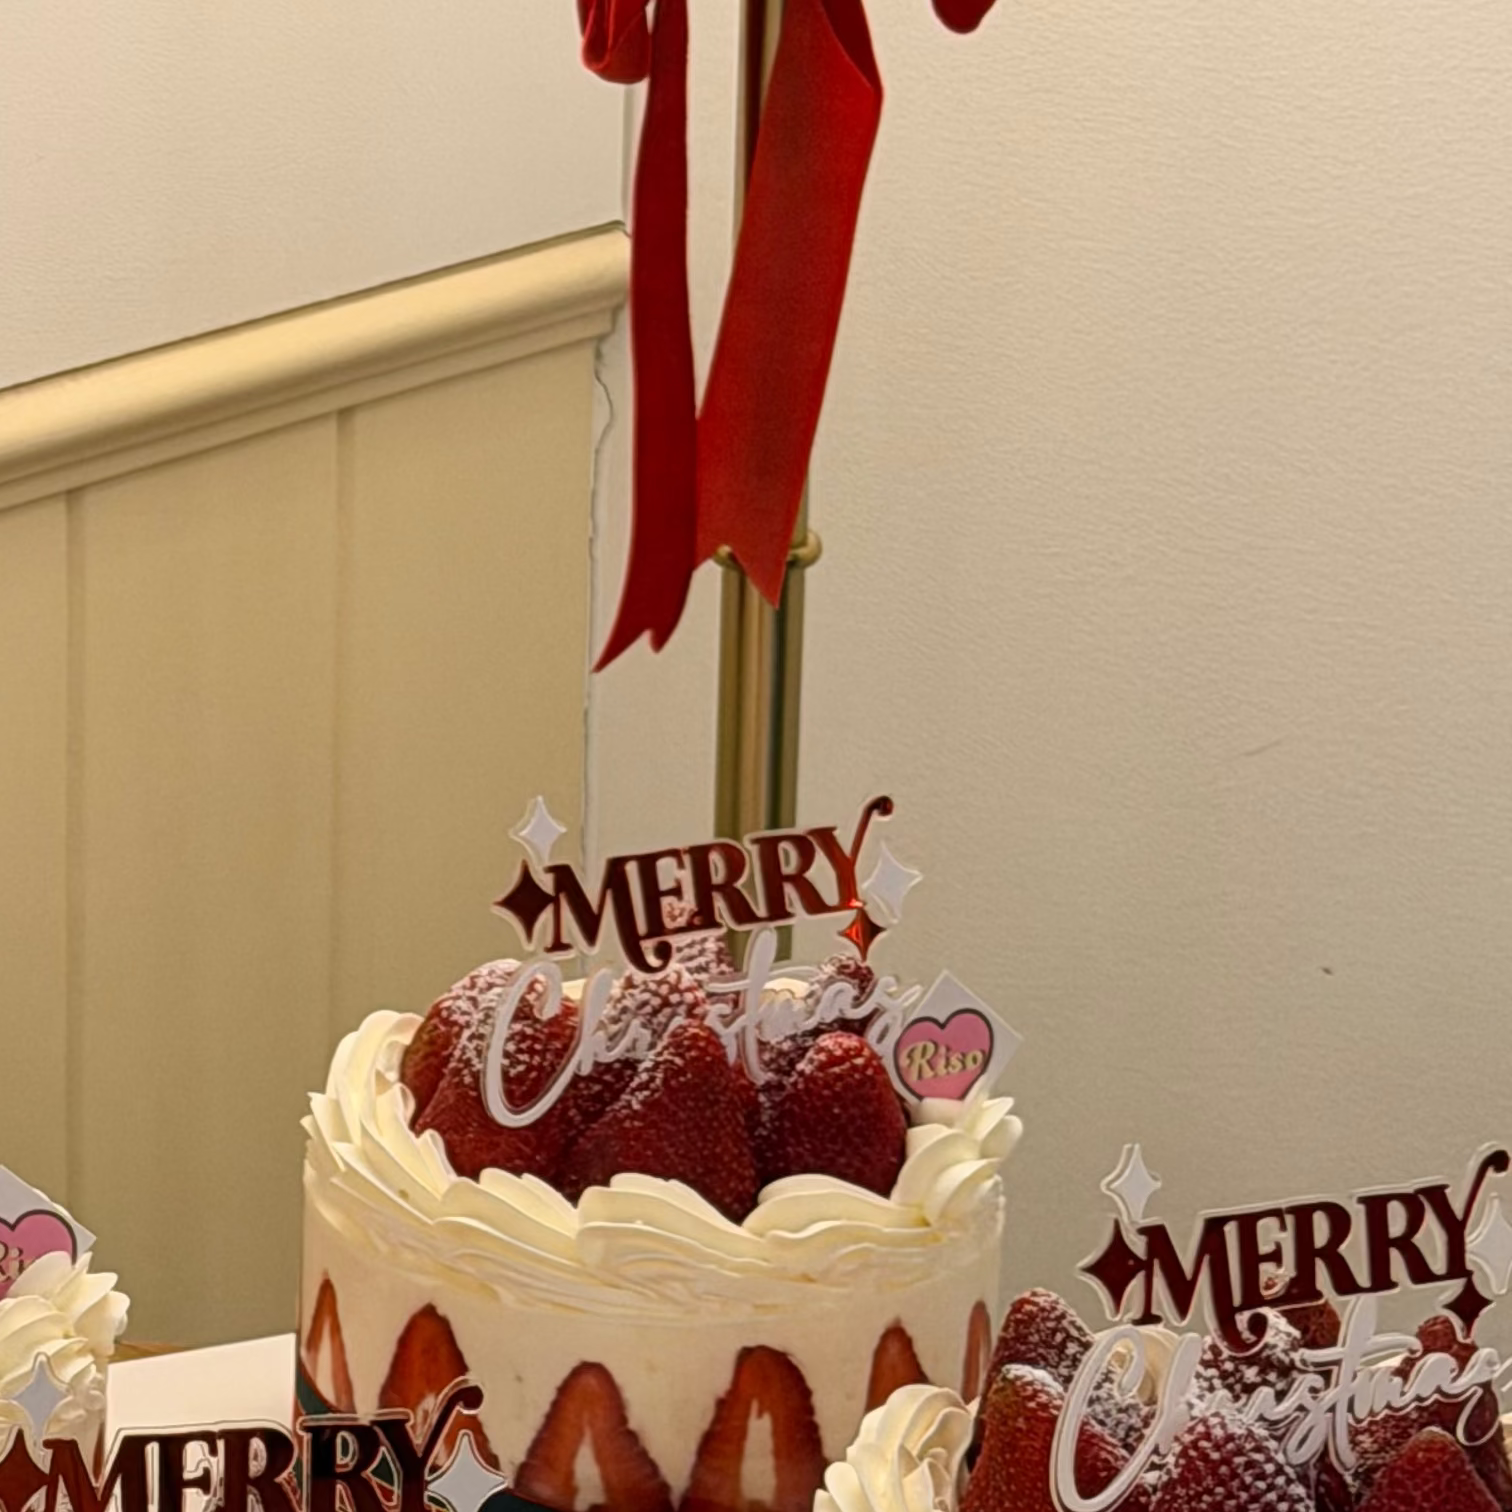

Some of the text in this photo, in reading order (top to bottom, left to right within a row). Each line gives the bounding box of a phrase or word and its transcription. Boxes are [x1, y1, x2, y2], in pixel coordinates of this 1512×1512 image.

[544, 795, 894, 973] MERRY
[899, 1039, 987, 1083] Riso
[1136, 1148, 1510, 1355] MERRY
